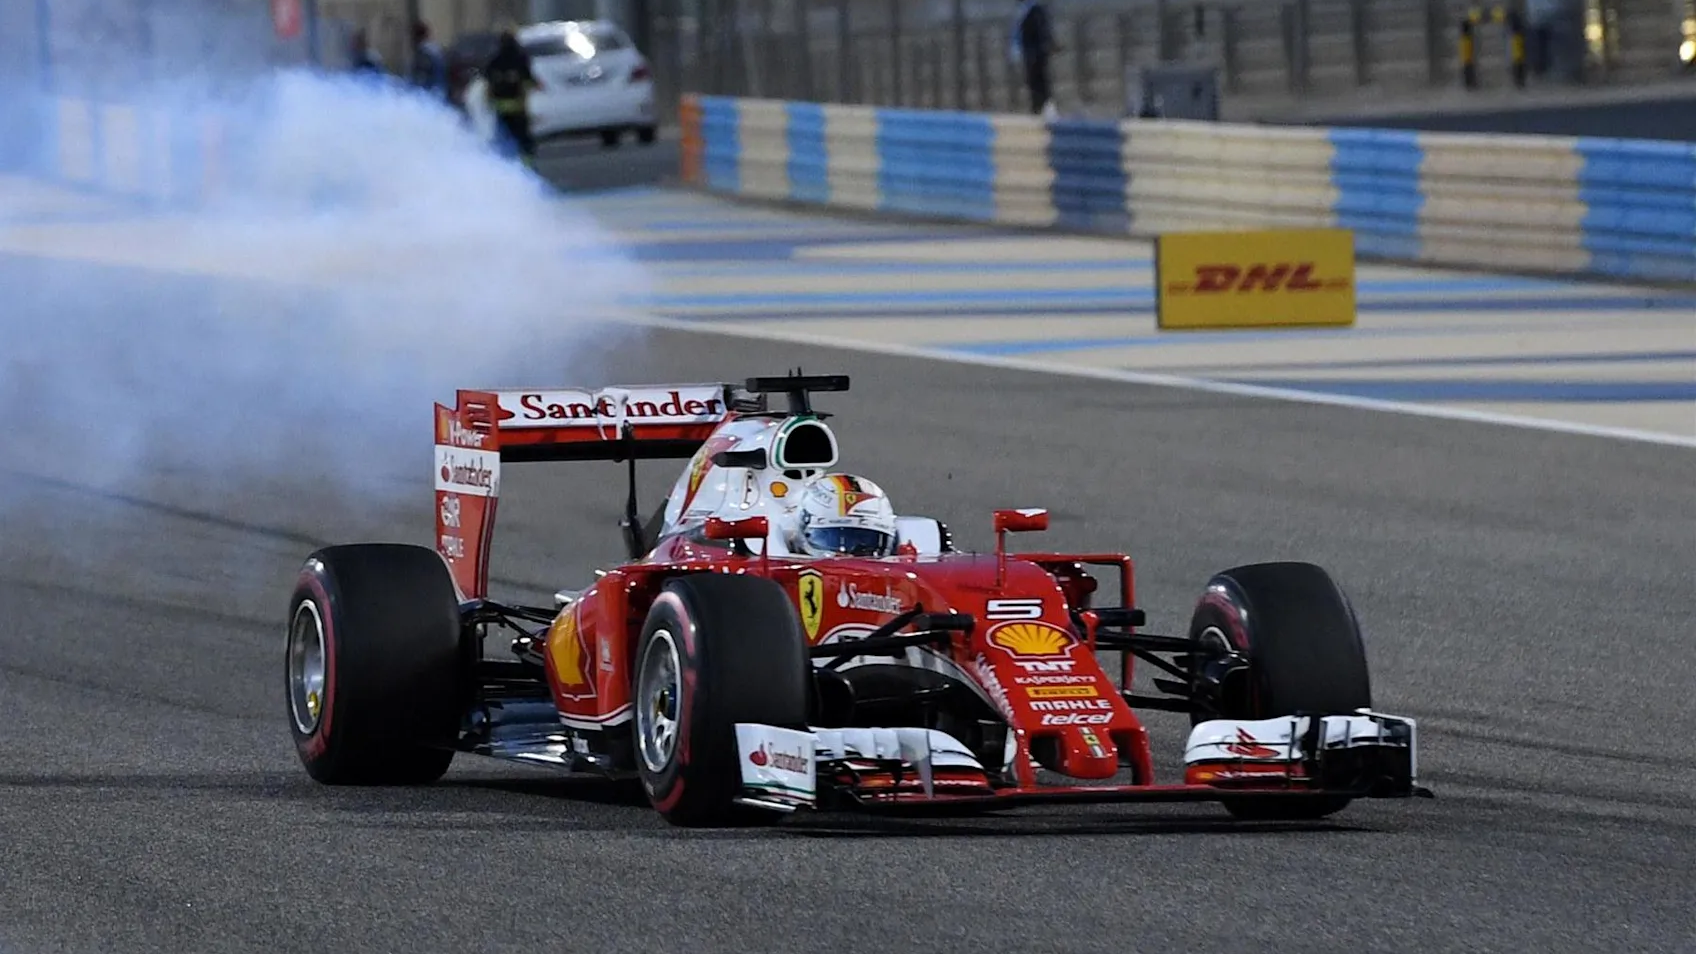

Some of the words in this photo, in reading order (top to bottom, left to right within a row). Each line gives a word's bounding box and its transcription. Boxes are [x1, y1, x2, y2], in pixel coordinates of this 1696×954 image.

[1194, 261, 1322, 292] DHL
[451, 455, 492, 491] Santander
[987, 599, 1042, 619] 5
[1014, 661, 1076, 671] TNT
[1029, 699, 1112, 711] MAHLE
[1041, 712, 1114, 725] telcel
[768, 741, 808, 774] Santander
